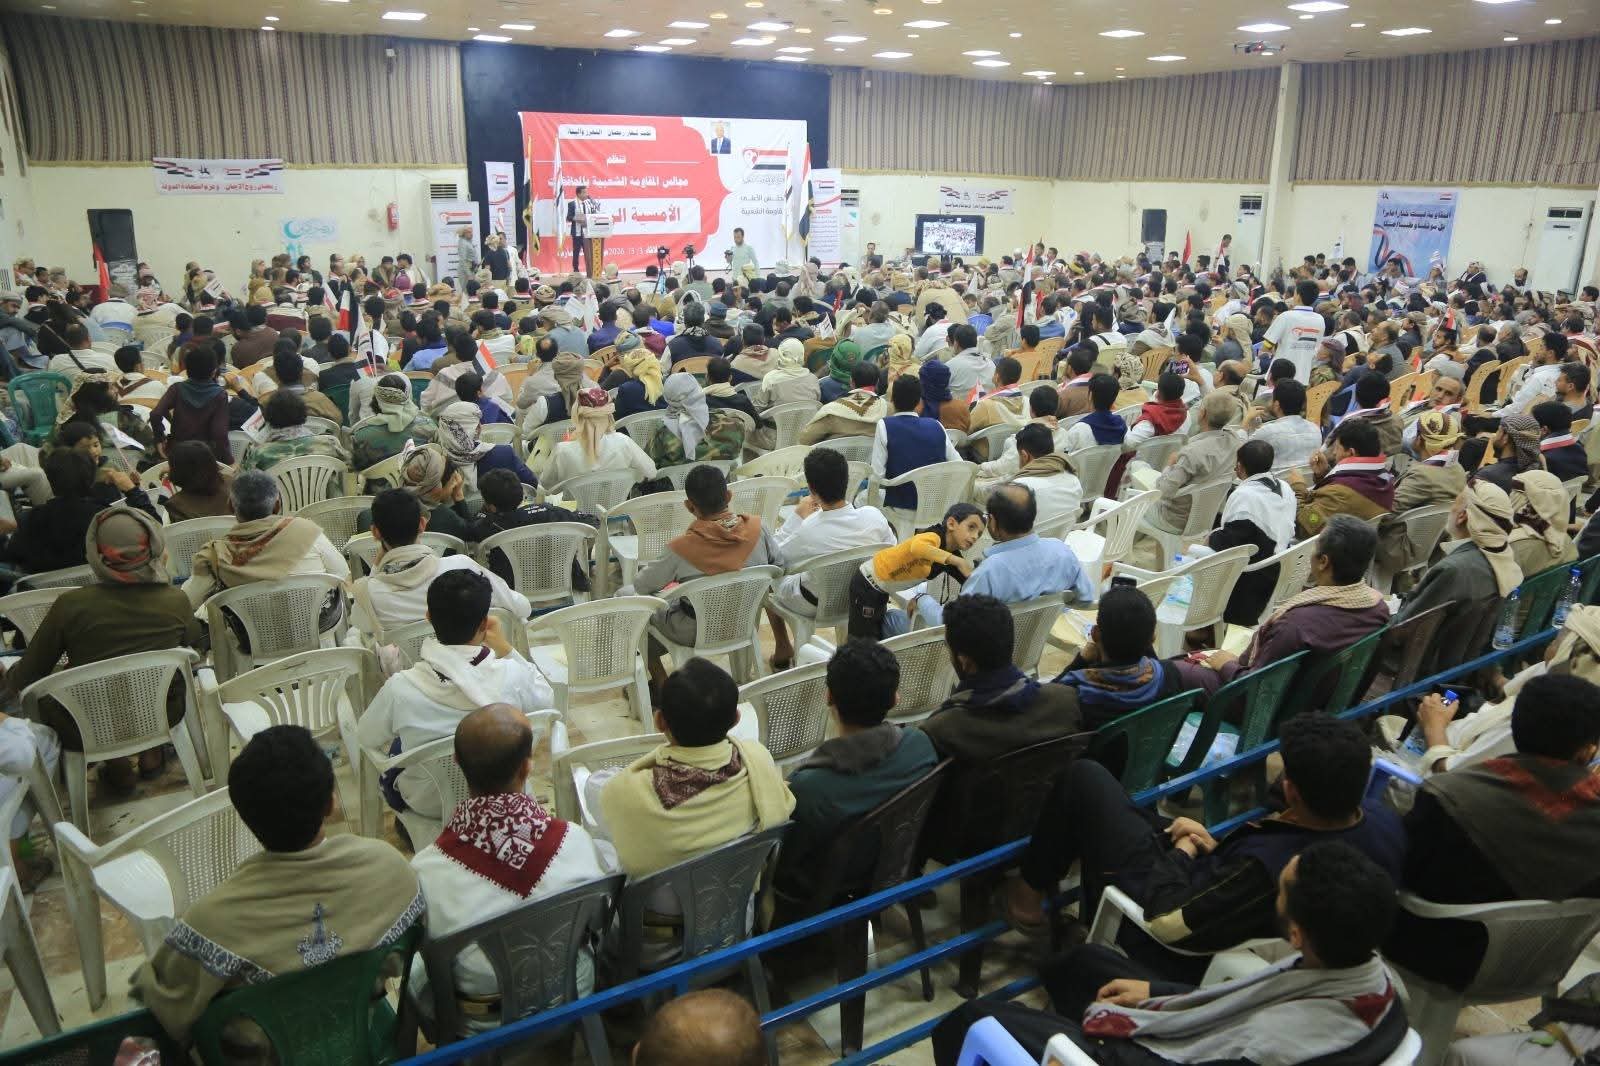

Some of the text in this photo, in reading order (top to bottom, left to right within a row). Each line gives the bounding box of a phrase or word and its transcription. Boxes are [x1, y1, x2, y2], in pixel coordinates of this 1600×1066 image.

[547, 175, 688, 188] مجالس المقاومة الشعبية بالمحافظت
[631, 204, 680, 225] الأمسية
